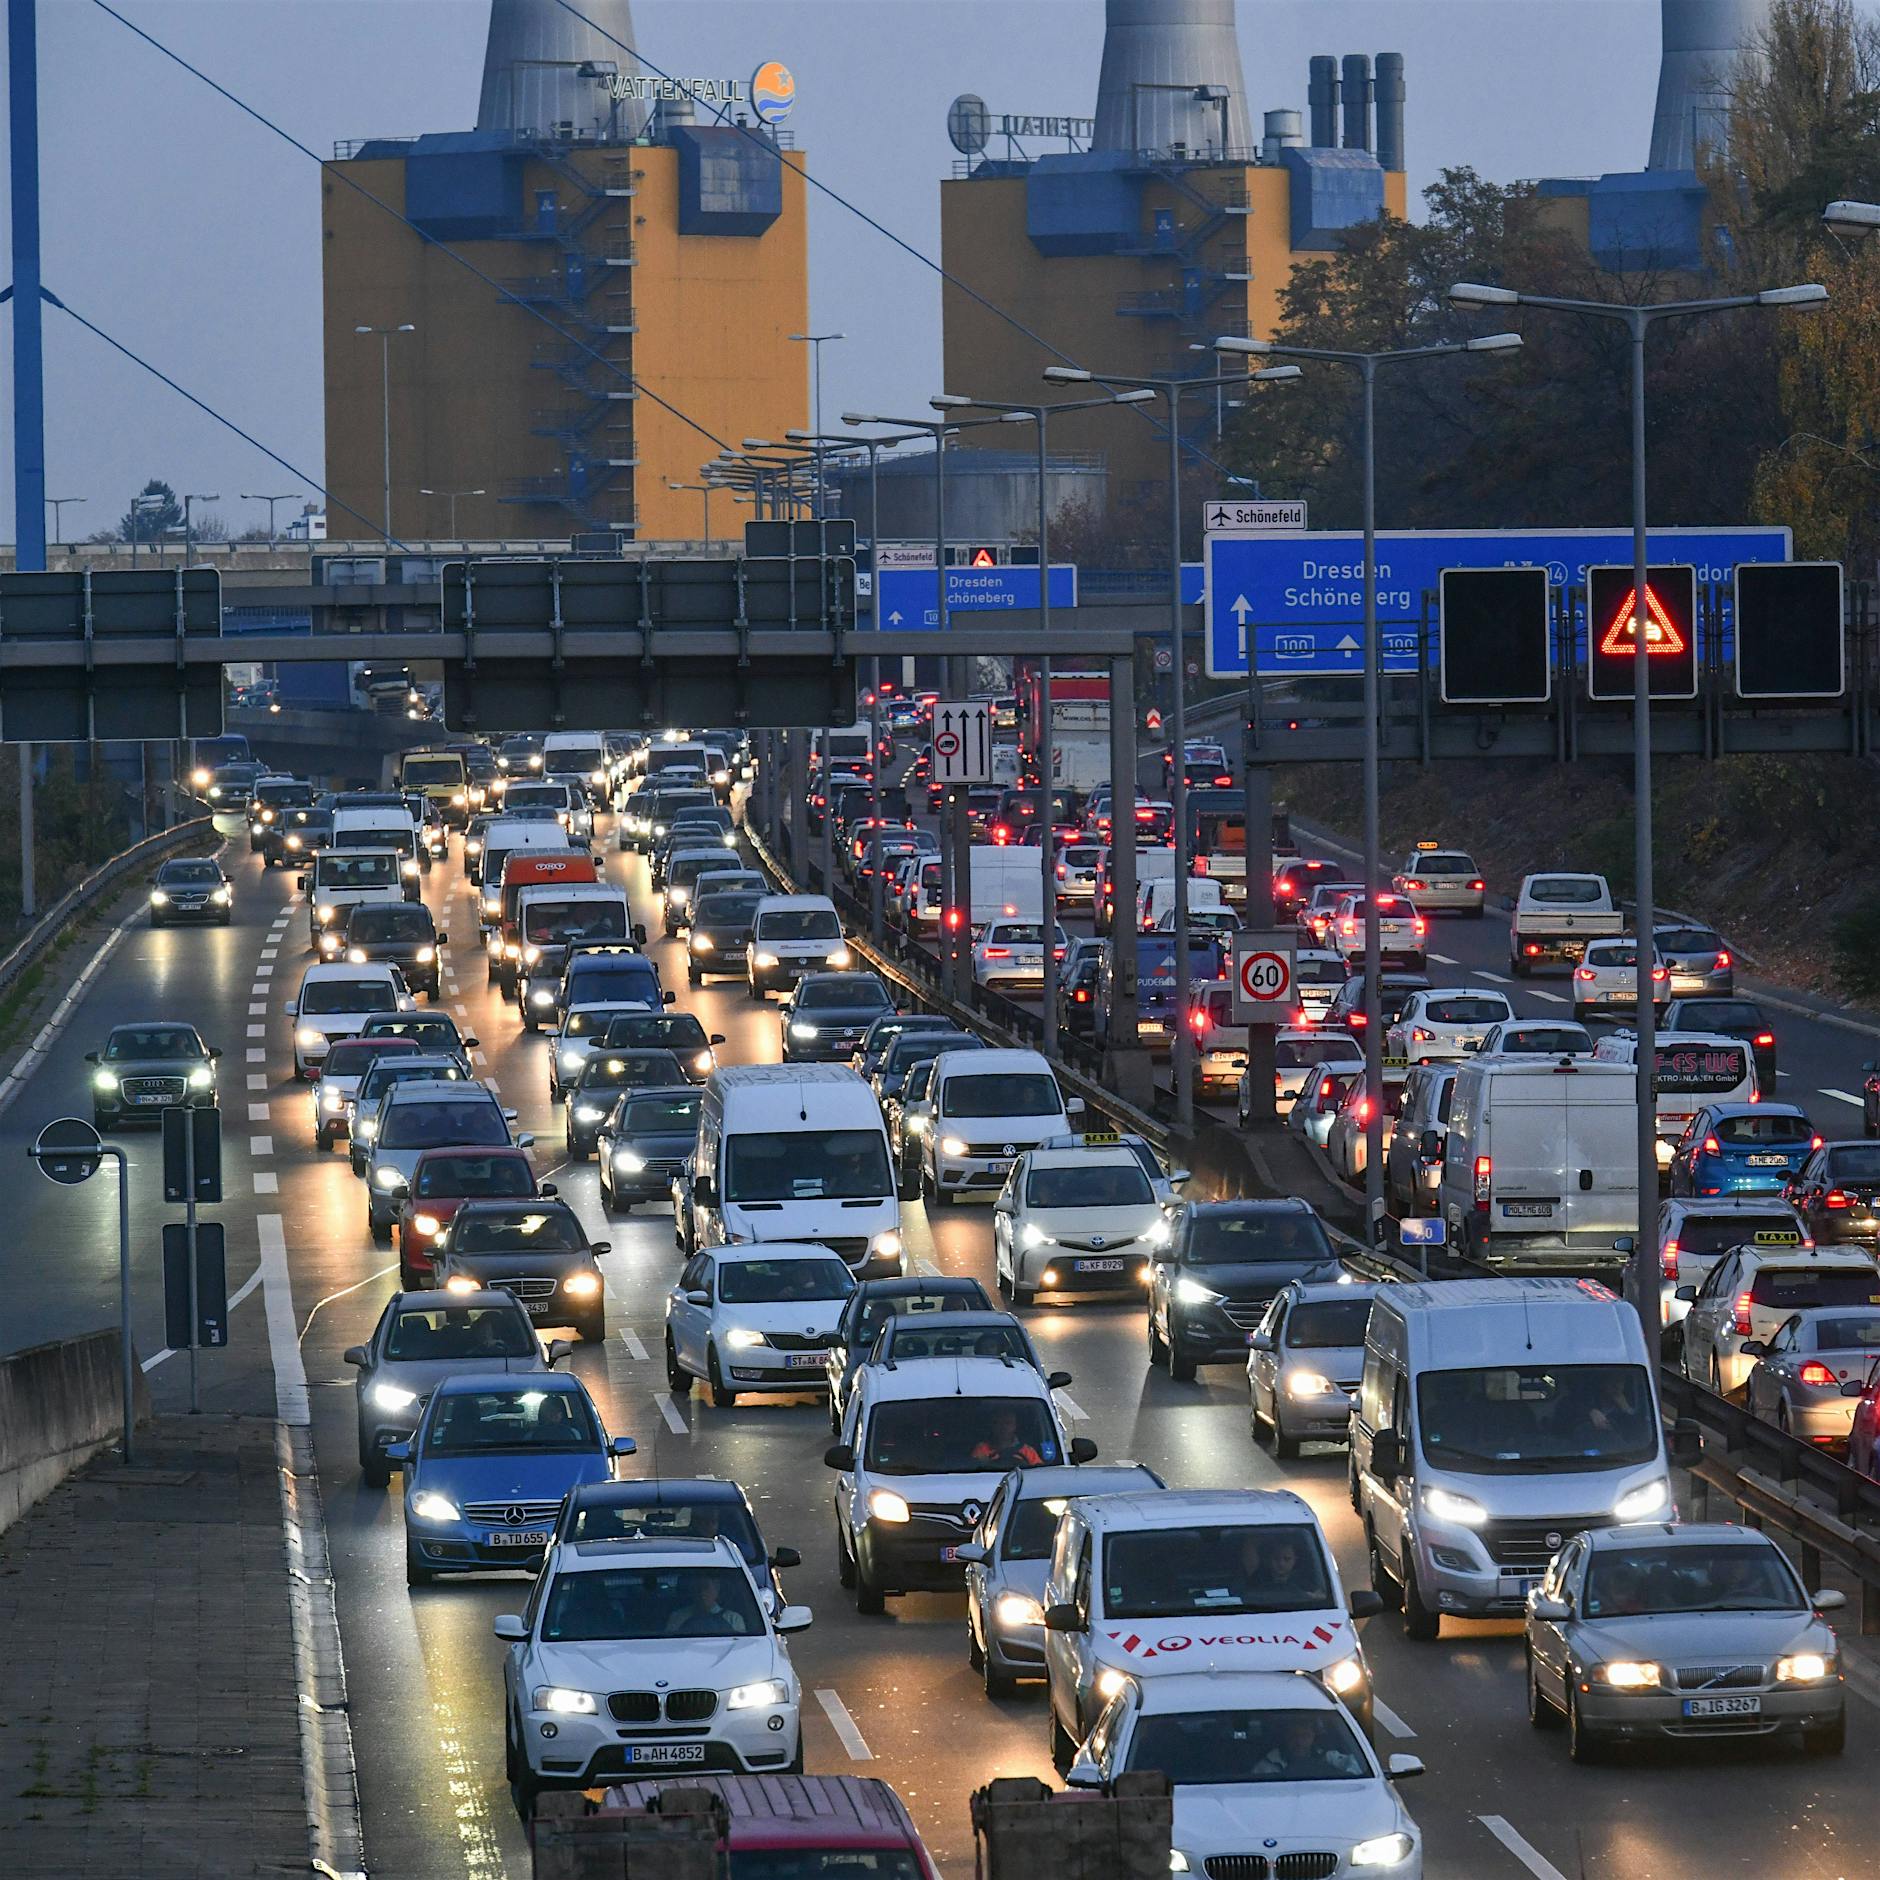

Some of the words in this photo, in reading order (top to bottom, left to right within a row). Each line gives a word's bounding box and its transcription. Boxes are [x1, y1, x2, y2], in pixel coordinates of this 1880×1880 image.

[606, 75, 745, 102] VATTENFALL
[1235, 509, 1301, 523] Schönefeld
[893, 552, 933, 561] Schönefeld
[1549, 567, 1563, 581] 14
[859, 578, 870, 589] Be
[949, 576, 1003, 588] Dresden
[945, 592, 1015, 605] chöneberg
[1284, 588, 1411, 609] Schöneerg
[1282, 640, 1308, 653] 100
[1388, 639, 1413, 652] 100
[1252, 965, 1278, 987] 60
[1079, 1261, 1085, 1270] B
[1090, 1261, 1101, 1269] KF
[1102, 1260, 1122, 1269] 8929
[528, 1303, 547, 1312] 3439
[792, 1357, 802, 1366] ST
[494, 1535, 500, 1544] B
[508, 1534, 522, 1544] TD
[523, 1533, 544, 1544] 655
[947, 1548, 954, 1559] B
[1199, 1635, 1300, 1645] VEOLIA
[1691, 1702, 1700, 1714] B
[1726, 1699, 1758, 1712] 3267
[633, 1748, 642, 1760] B
[651, 1748, 668, 1760] AH
[670, 1746, 702, 1760] 4852
